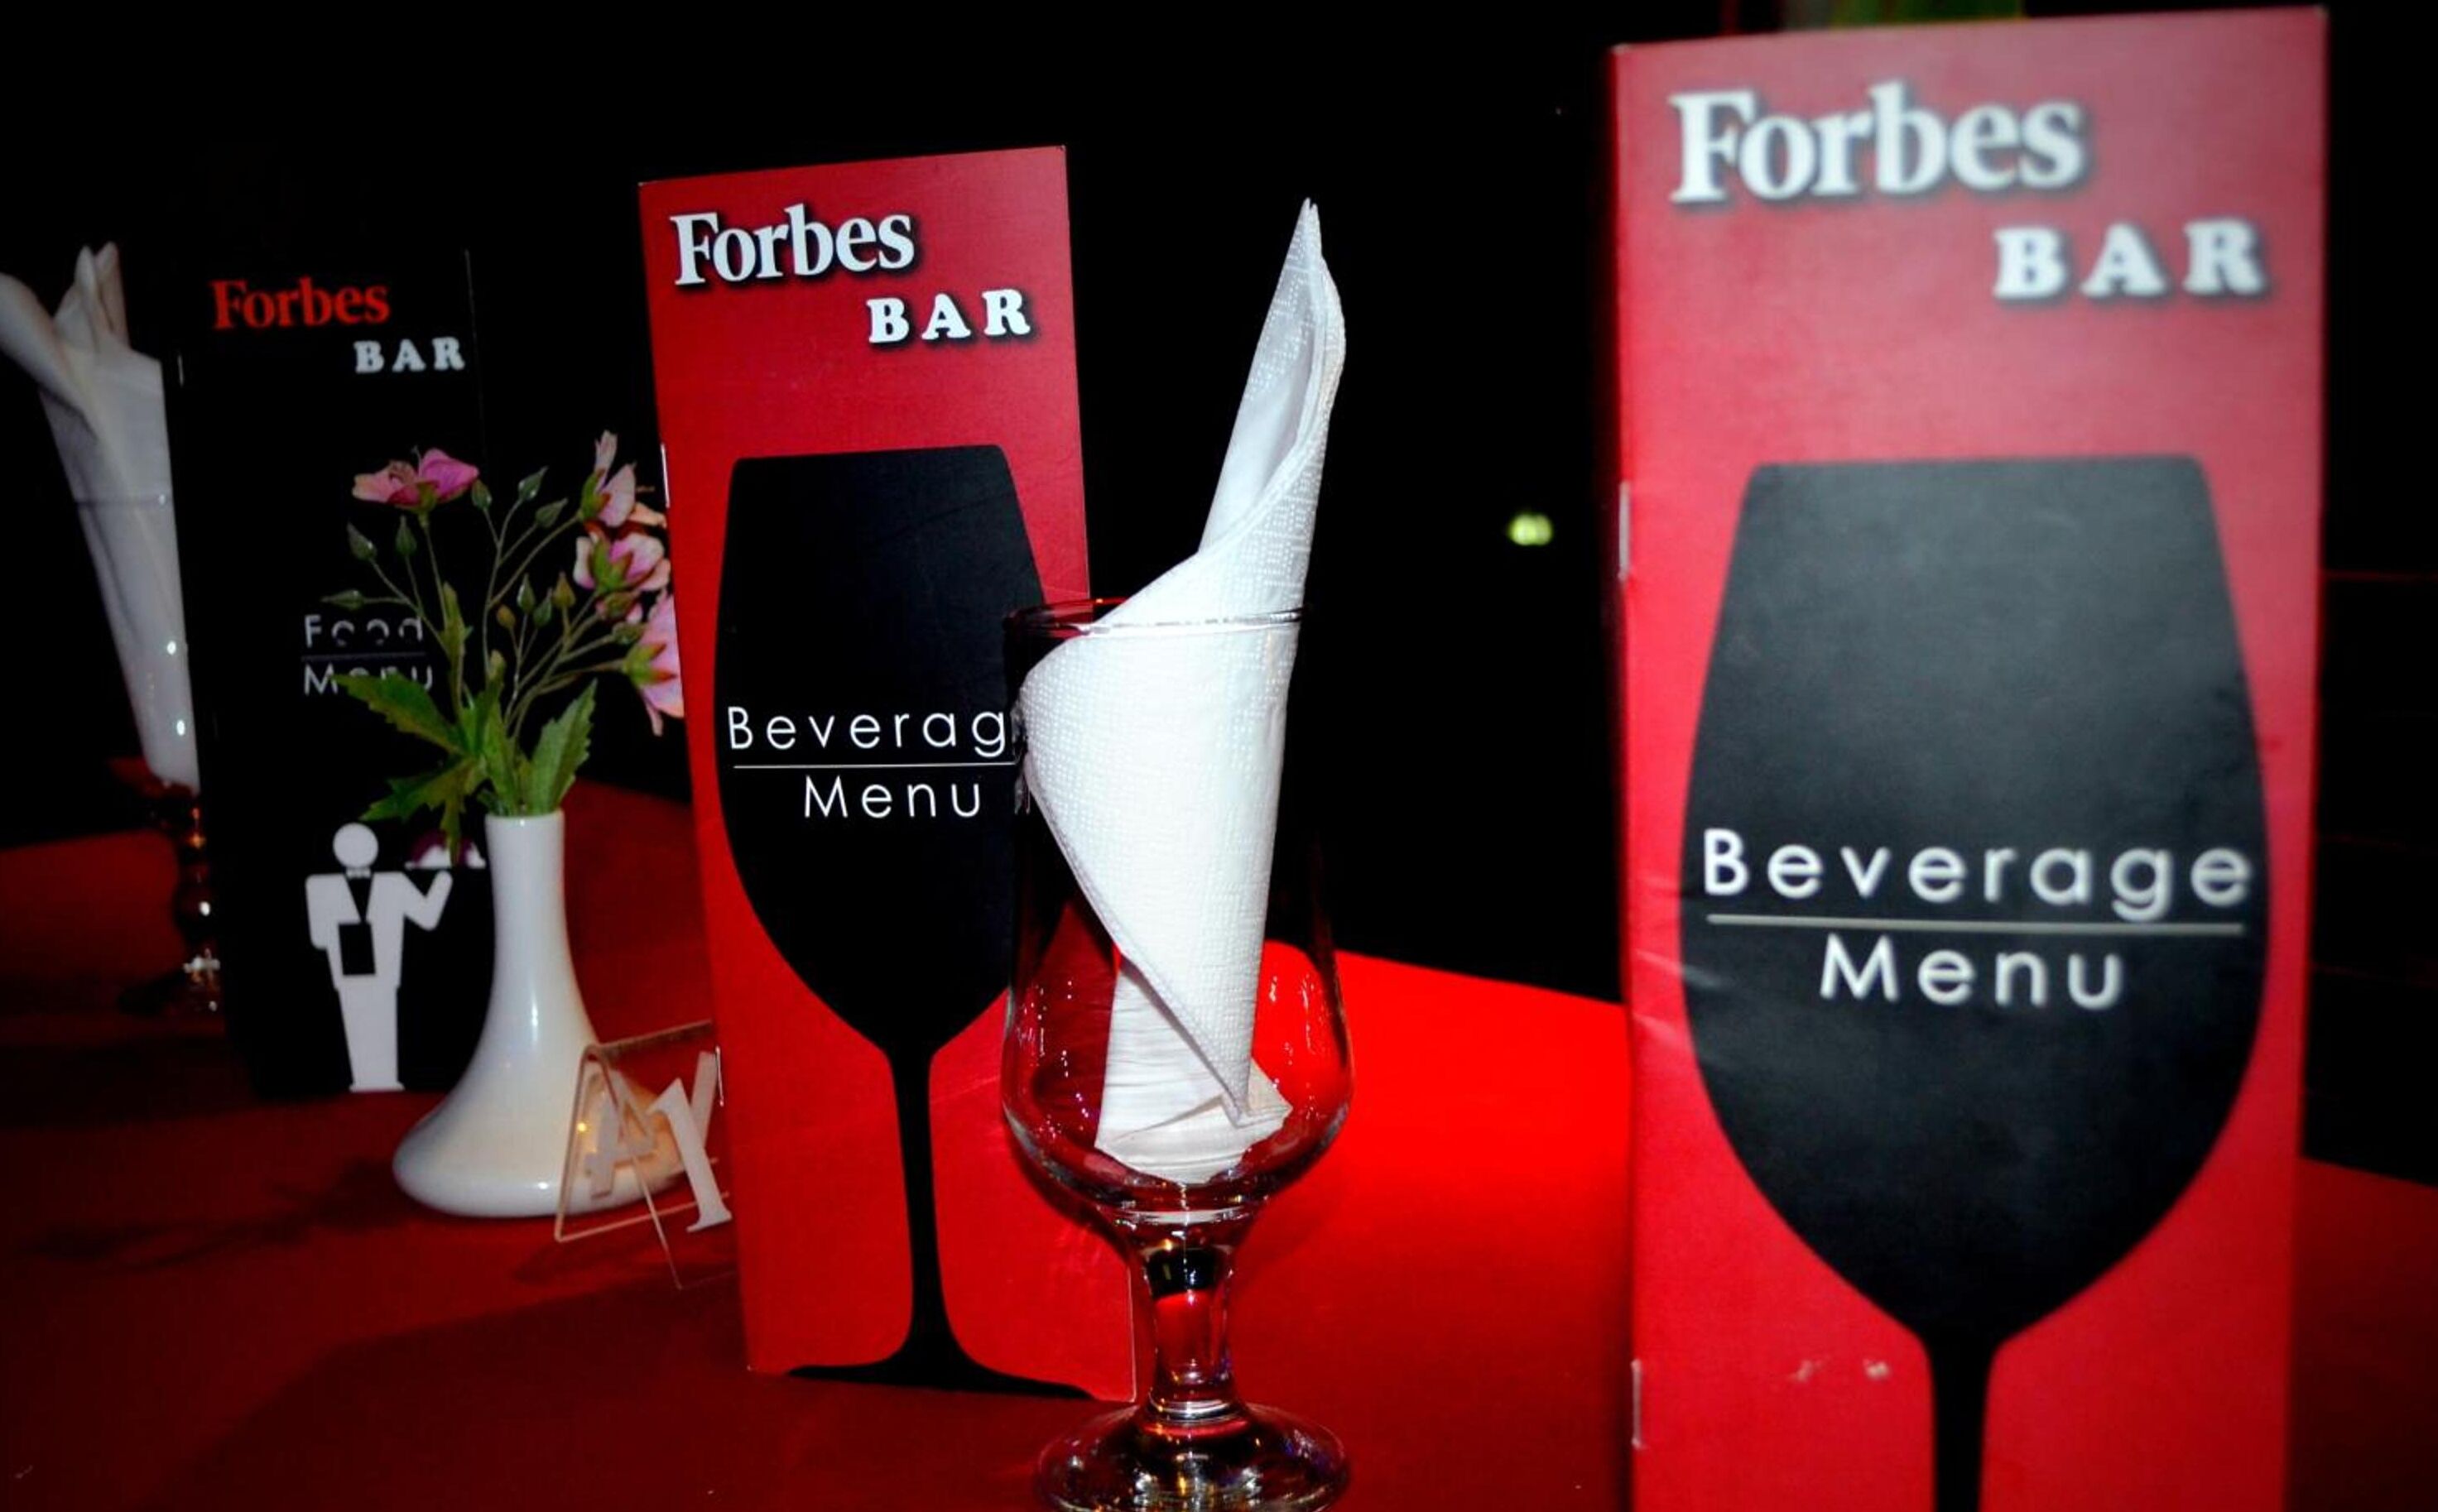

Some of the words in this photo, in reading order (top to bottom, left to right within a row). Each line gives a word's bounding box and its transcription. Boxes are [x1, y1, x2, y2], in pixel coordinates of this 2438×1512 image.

[1666, 79, 2085, 204] Forbes
[669, 203, 915, 286] Forbes
[1992, 217, 2267, 300] BAR
[209, 274, 390, 329] Forbes
[866, 289, 1031, 343] BAR
[353, 336, 465, 373] BAR
[727, 706, 1023, 758] Beverag
[804, 775, 981, 818] Menu
[1702, 827, 2253, 922] Beverage
[1820, 932, 2123, 1011] Menu
